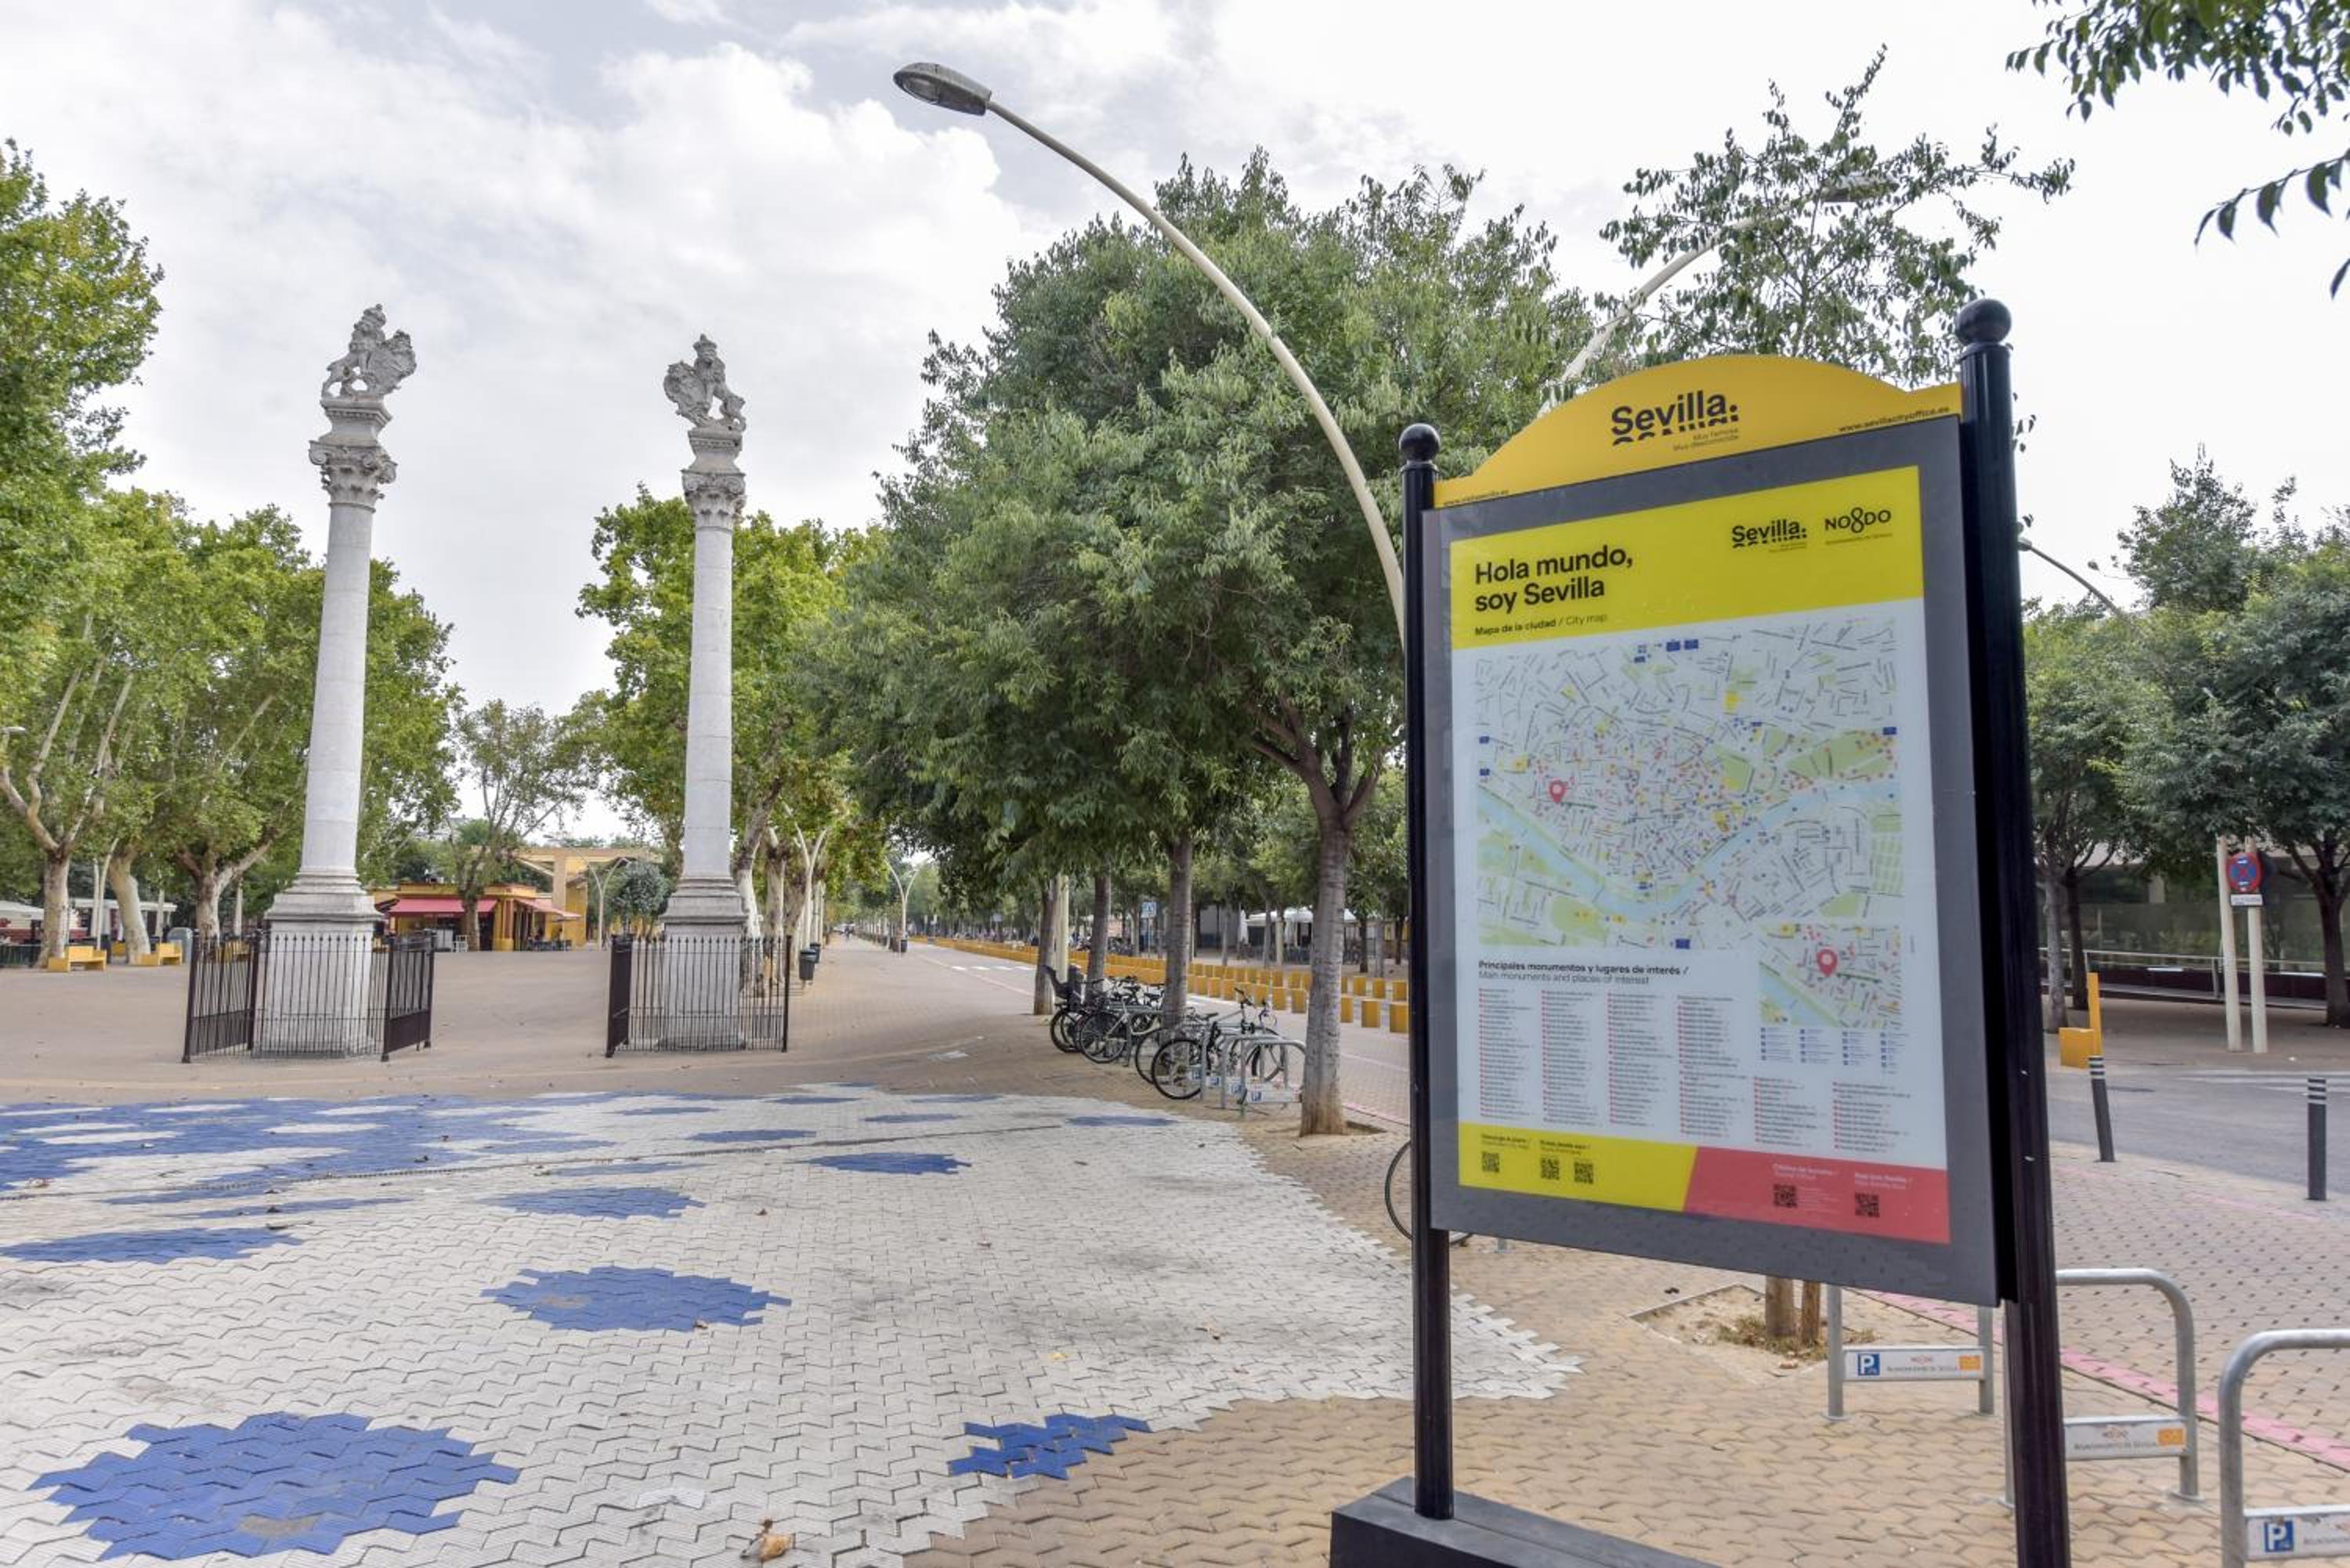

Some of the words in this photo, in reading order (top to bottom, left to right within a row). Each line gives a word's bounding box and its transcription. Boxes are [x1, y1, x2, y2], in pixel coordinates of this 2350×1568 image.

[1476, 558, 1529, 585] Hola
[1536, 544, 1632, 576] mundo,
[1475, 592, 1517, 614] soy
[1524, 576, 1605, 605] Sevilla
[1475, 625, 1500, 636] Mapa
[1502, 623, 1513, 633] de
[1514, 622, 1524, 631] la
[1525, 620, 1556, 631] ciudad
[1566, 616, 1585, 627] City
[1586, 614, 1608, 625] map
[1478, 960, 1525, 970] Principales
[1528, 963, 1586, 972] monumentos
[1587, 966, 1594, 974] y
[1596, 965, 1630, 975] lugares
[1632, 965, 1644, 974] de
[1646, 965, 1680, 975] interés
